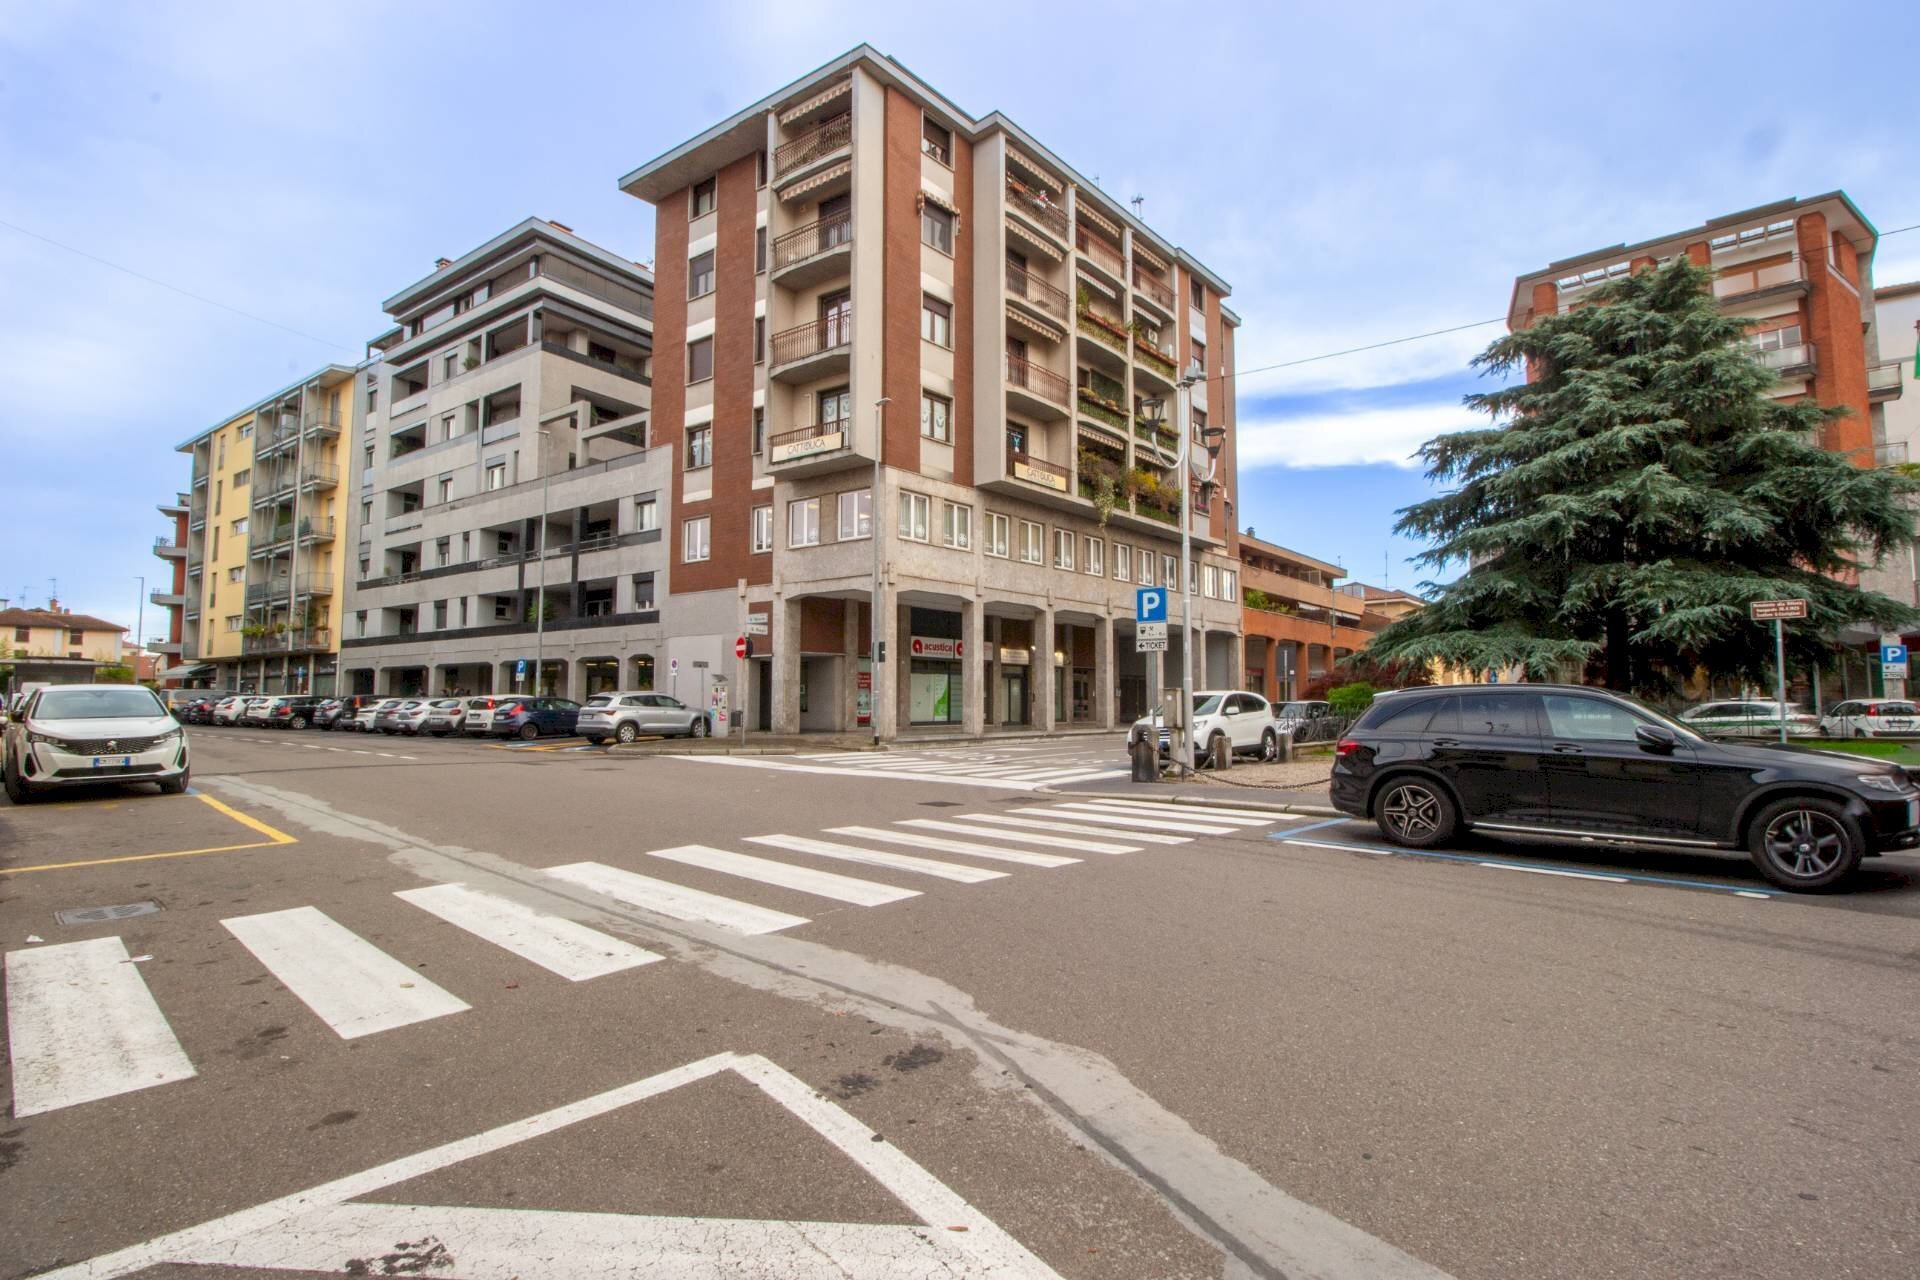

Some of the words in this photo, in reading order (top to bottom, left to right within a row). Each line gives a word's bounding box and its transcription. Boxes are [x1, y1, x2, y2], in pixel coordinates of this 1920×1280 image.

[1142, 592, 1160, 618] P
[924, 642, 953, 652] acustica
[1145, 641, 1166, 650] TICKET
[1887, 647, 1901, 662] P
